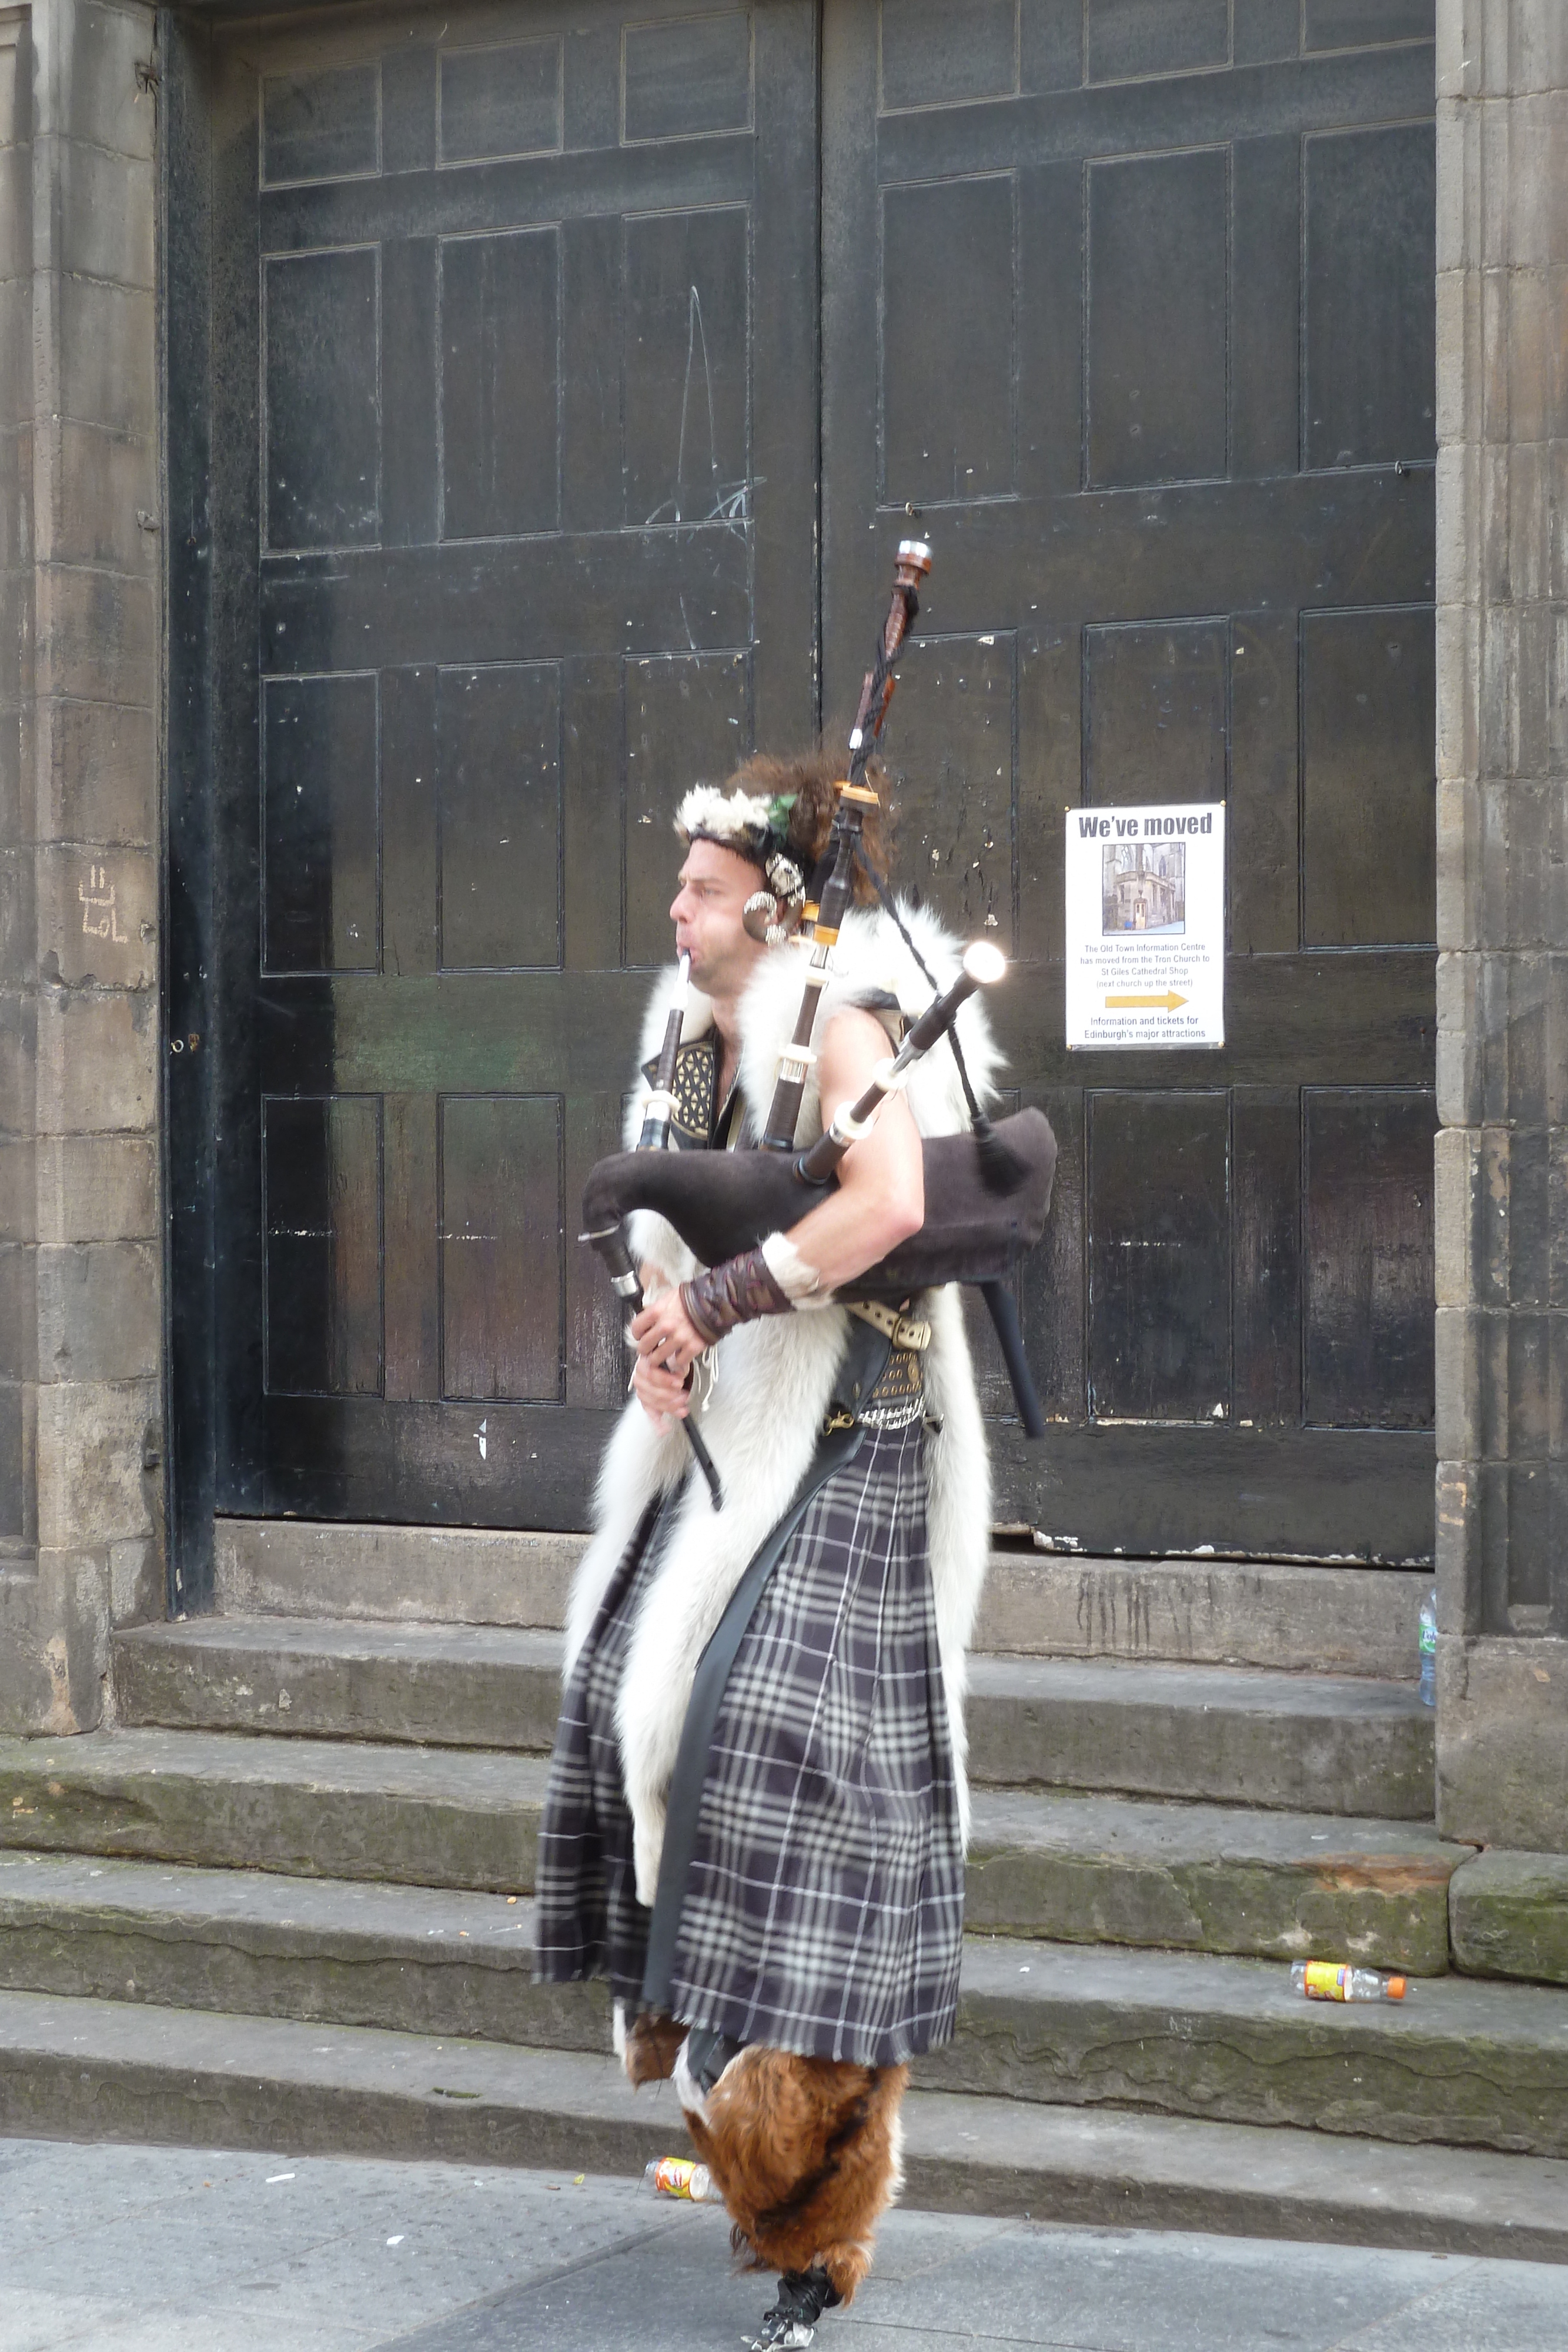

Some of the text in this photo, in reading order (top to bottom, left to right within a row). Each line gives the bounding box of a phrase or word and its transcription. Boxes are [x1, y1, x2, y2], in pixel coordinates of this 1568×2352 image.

[1079, 813, 1212, 838] We've moved
[1169, 967, 1189, 975] Shop
[1096, 980, 1115, 988] (next
[1169, 978, 1193, 987] street)
[1091, 1017, 1137, 1025] Information
[1139, 1017, 1155, 1025] and
[1186, 1016, 1199, 1024] for
[1085, 1028, 1206, 1040] Edinburgh's major attractions
